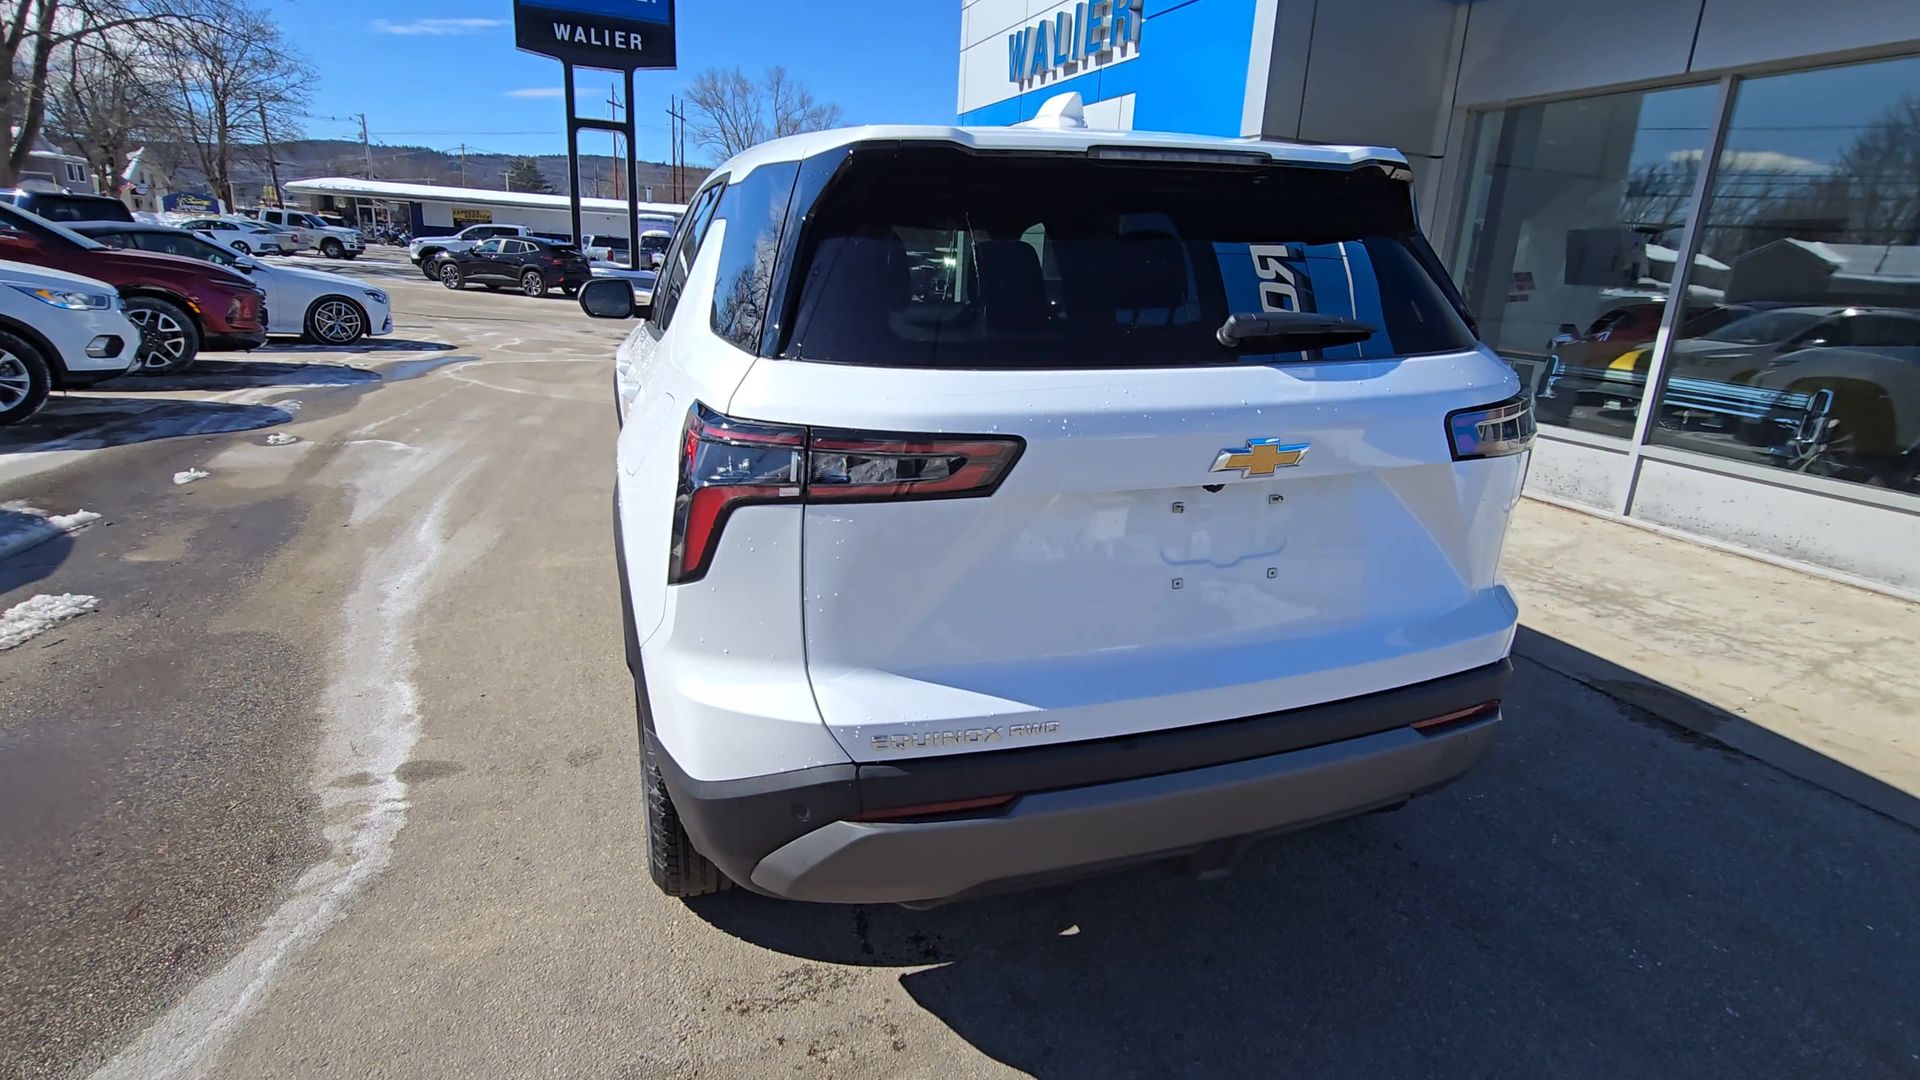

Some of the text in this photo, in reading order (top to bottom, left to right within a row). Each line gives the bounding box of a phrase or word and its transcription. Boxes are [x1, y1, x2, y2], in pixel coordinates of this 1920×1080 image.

[553, 22, 643, 51] WALIER
[1008, 0, 1141, 83] WALIER
[871, 720, 1060, 750] EQUINOX AWD
